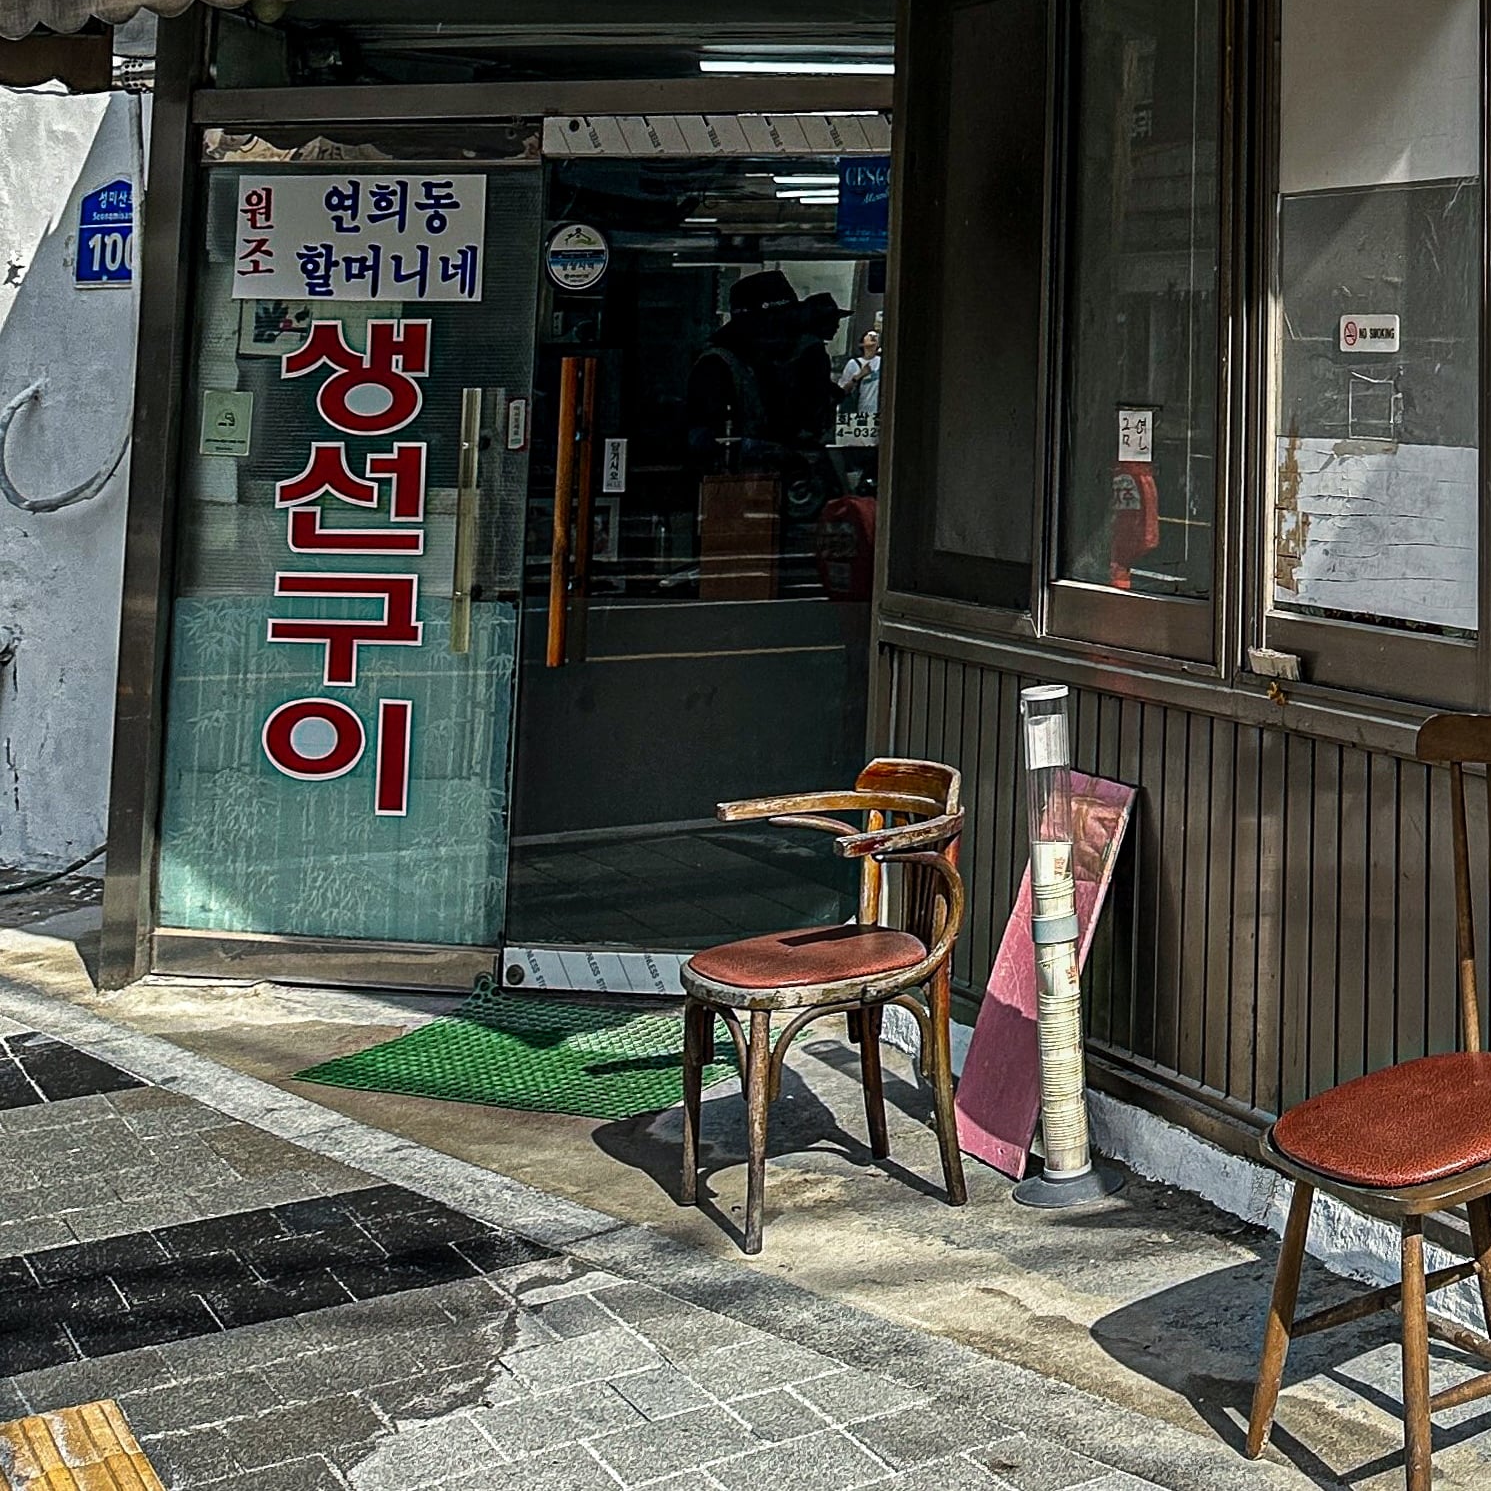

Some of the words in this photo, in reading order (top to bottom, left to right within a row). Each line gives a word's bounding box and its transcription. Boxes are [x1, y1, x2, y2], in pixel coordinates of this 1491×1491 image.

[239, 187, 274, 277] 원조
[324, 180, 461, 235] 연희동
[296, 243, 479, 299] 할머니네
[262, 318, 432, 816] 생선구이
